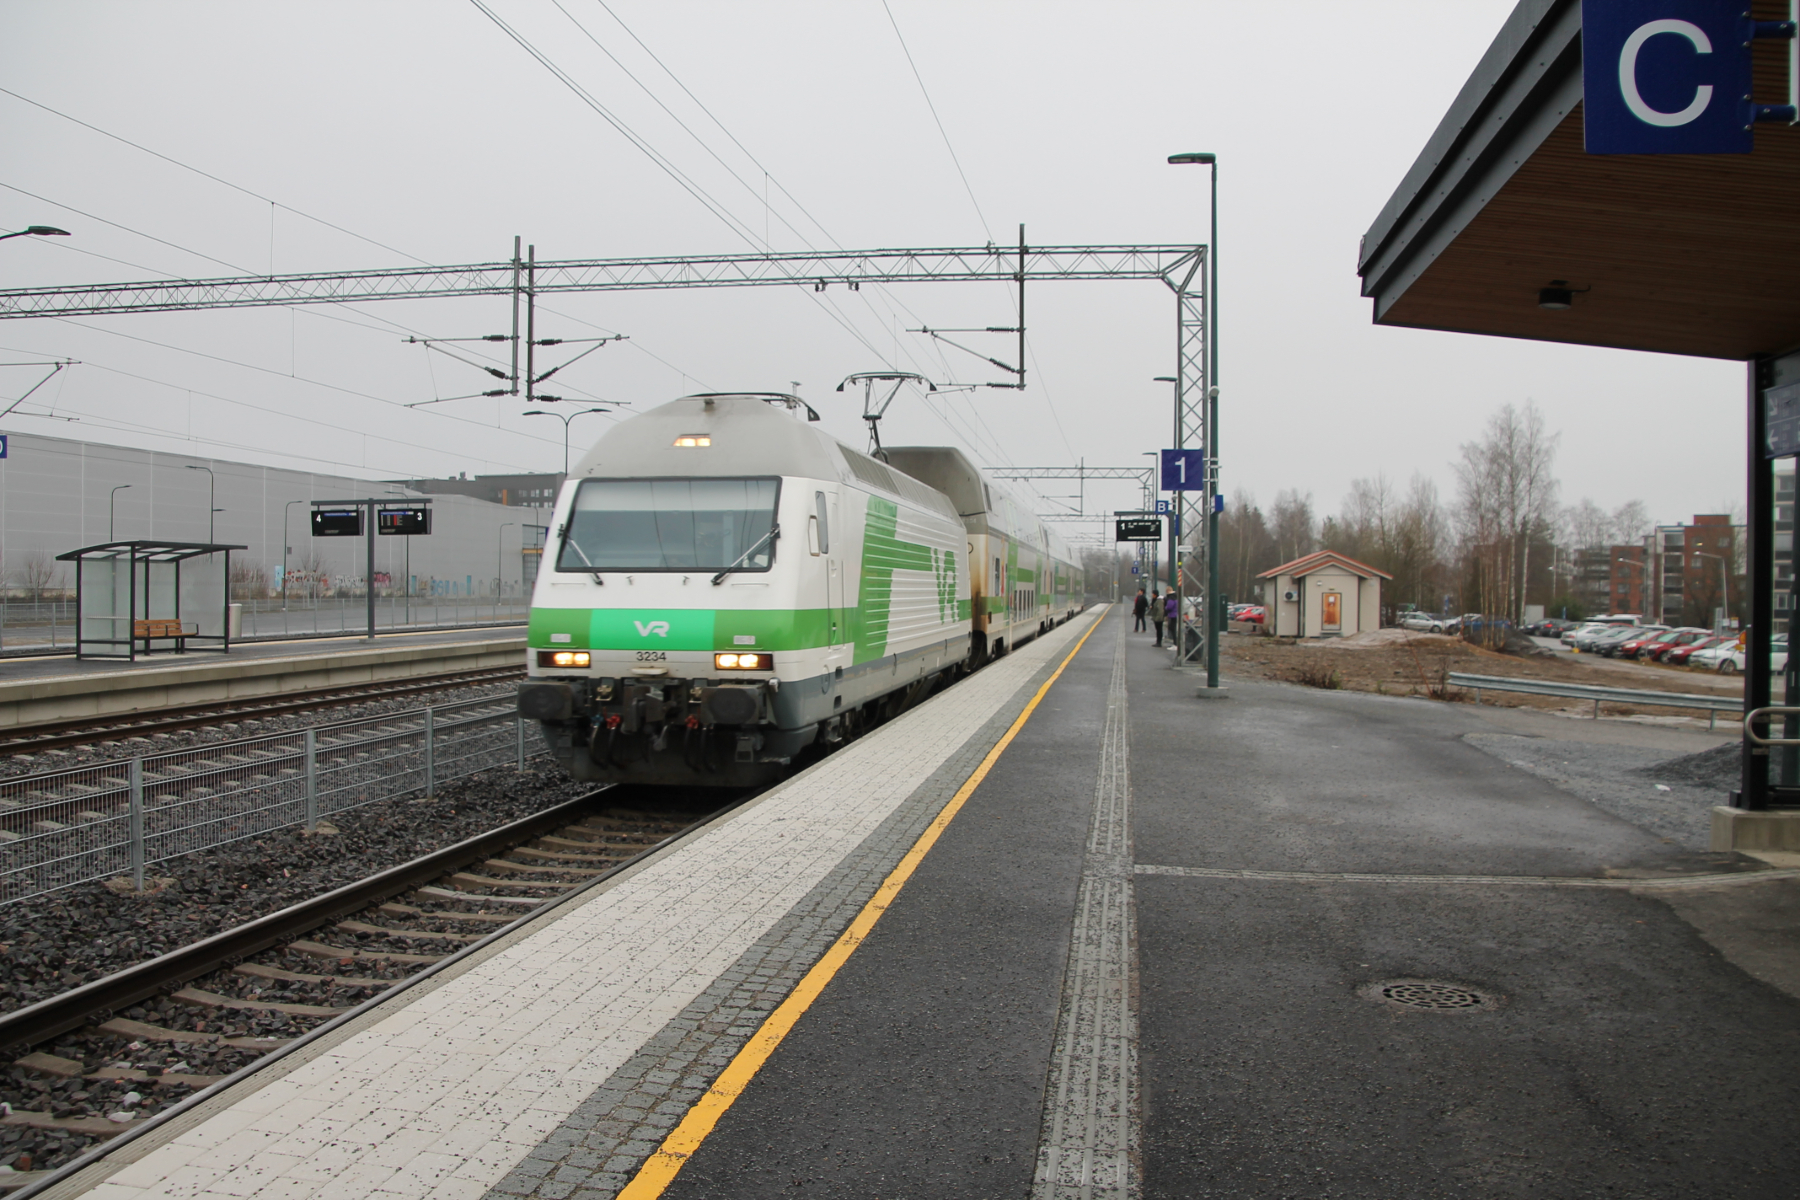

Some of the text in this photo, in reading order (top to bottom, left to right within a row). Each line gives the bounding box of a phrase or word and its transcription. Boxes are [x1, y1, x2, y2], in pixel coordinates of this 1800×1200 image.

[1619, 18, 1714, 127] C
[1174, 456, 1186, 484] 1
[1158, 502, 1166, 512] B
[316, 514, 322, 523] 4
[417, 512, 422, 521] 3
[933, 548, 957, 625] VR
[633, 621, 670, 637] VR
[636, 651, 667, 661] 3234
